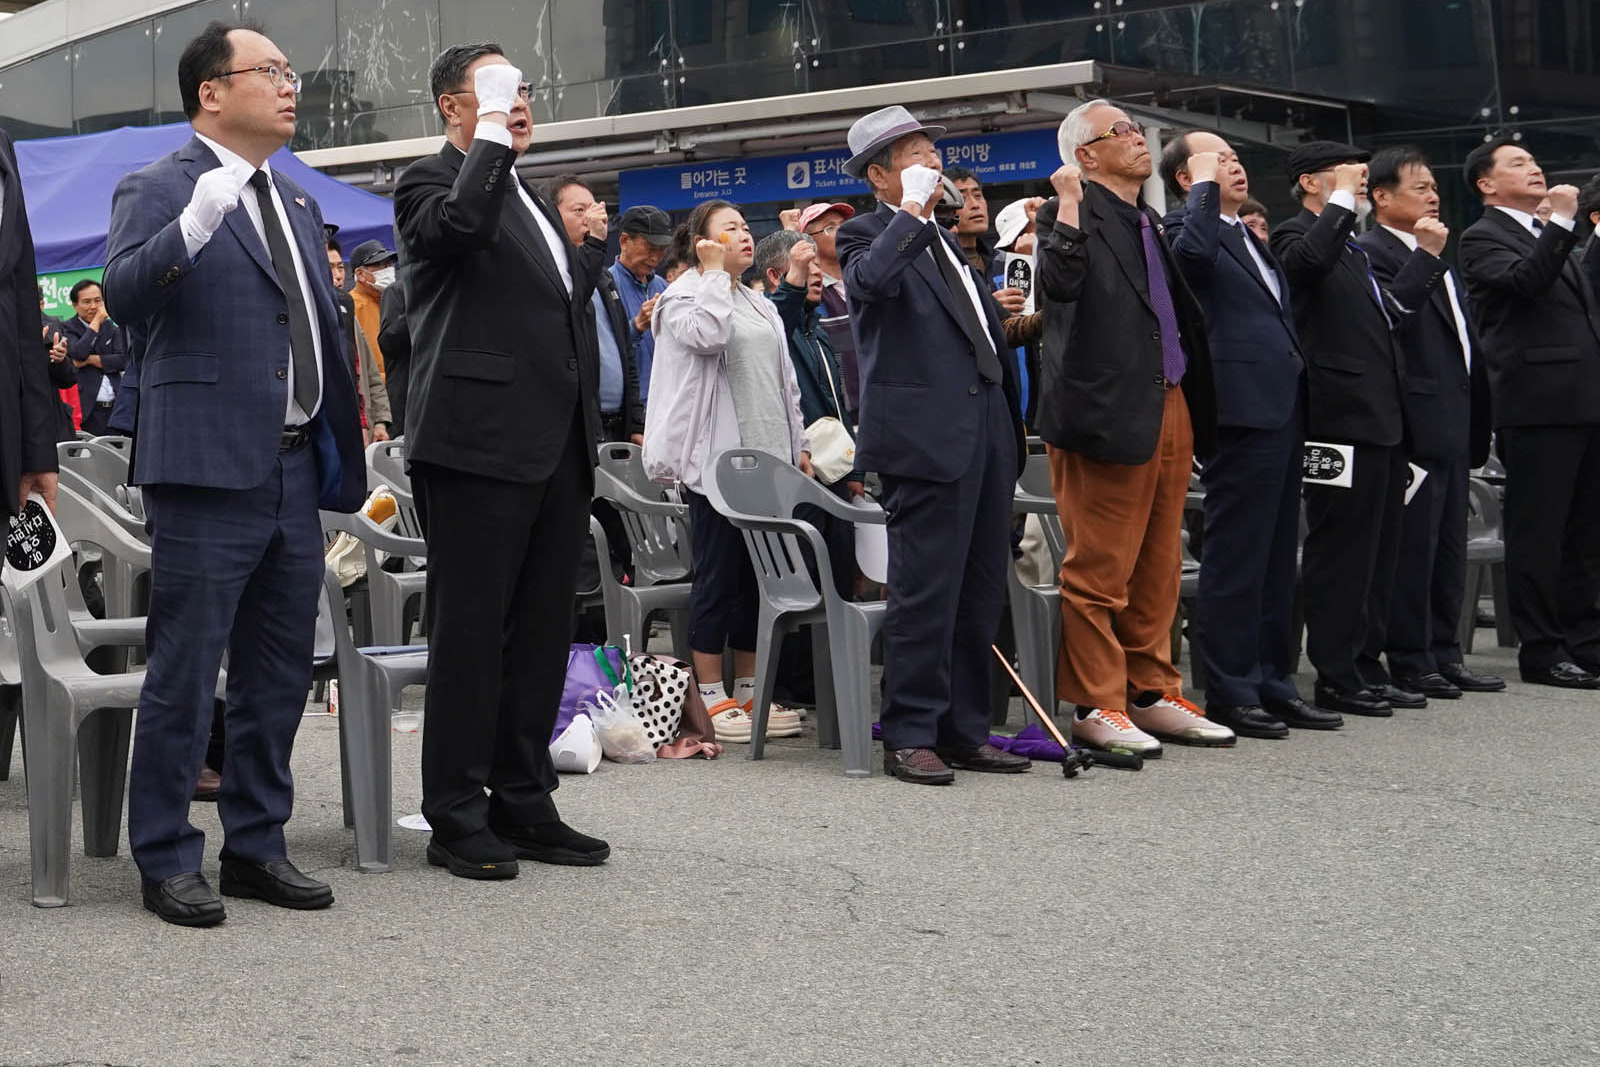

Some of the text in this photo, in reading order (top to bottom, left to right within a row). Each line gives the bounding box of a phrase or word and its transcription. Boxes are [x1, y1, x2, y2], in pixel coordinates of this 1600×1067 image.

[946, 142, 991, 164] 맞이방
[814, 157, 845, 175] 표사
[681, 166, 747, 190] 들어가는 곳
[693, 191, 719, 199] Entrance
[8, 515, 42, 547] 다시 만난
[21, 534, 40, 554] 오월
[28, 551, 43, 568] 아!
